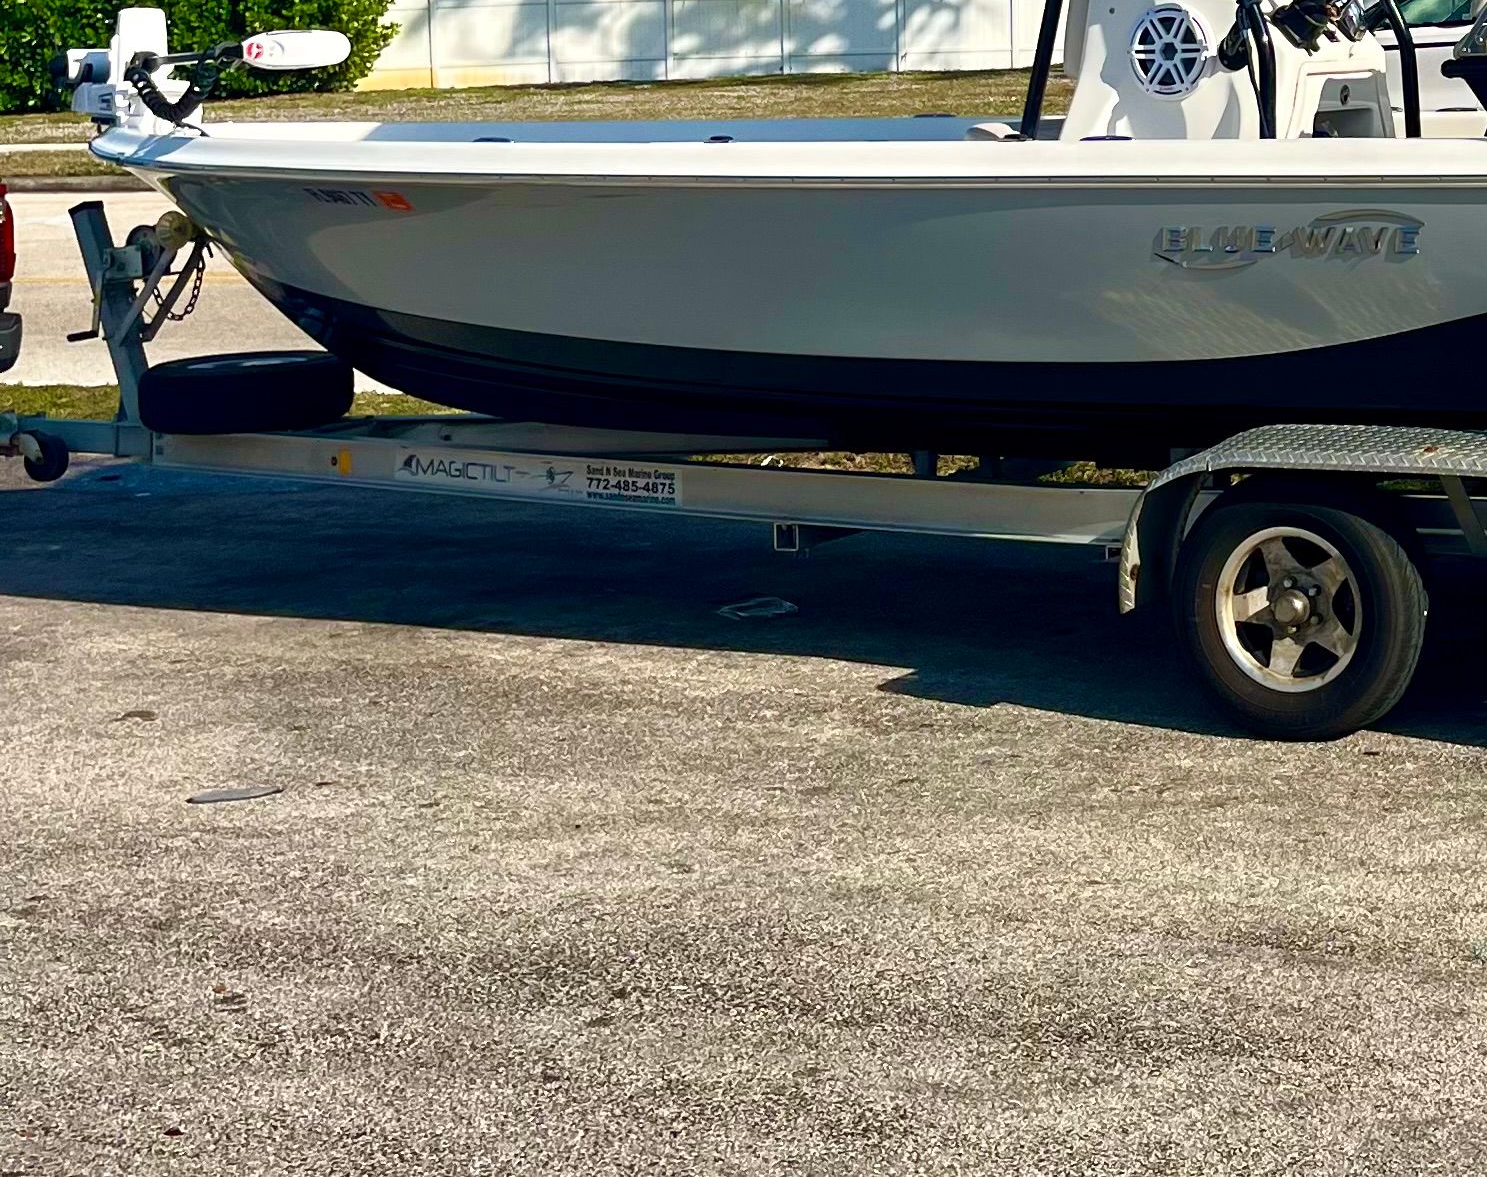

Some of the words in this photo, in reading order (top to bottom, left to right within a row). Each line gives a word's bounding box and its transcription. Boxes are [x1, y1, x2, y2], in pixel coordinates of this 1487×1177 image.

[1160, 225, 1277, 254] BLUE
[1295, 225, 1421, 256] WAVE
[415, 457, 517, 483] MAGICTILT
[586, 464, 604, 476] Sand
[605, 466, 612, 476] N
[613, 466, 627, 478] Sea
[628, 467, 652, 479] Marine
[653, 469, 676, 482] Group
[586, 476, 676, 495] 772-485-4875
